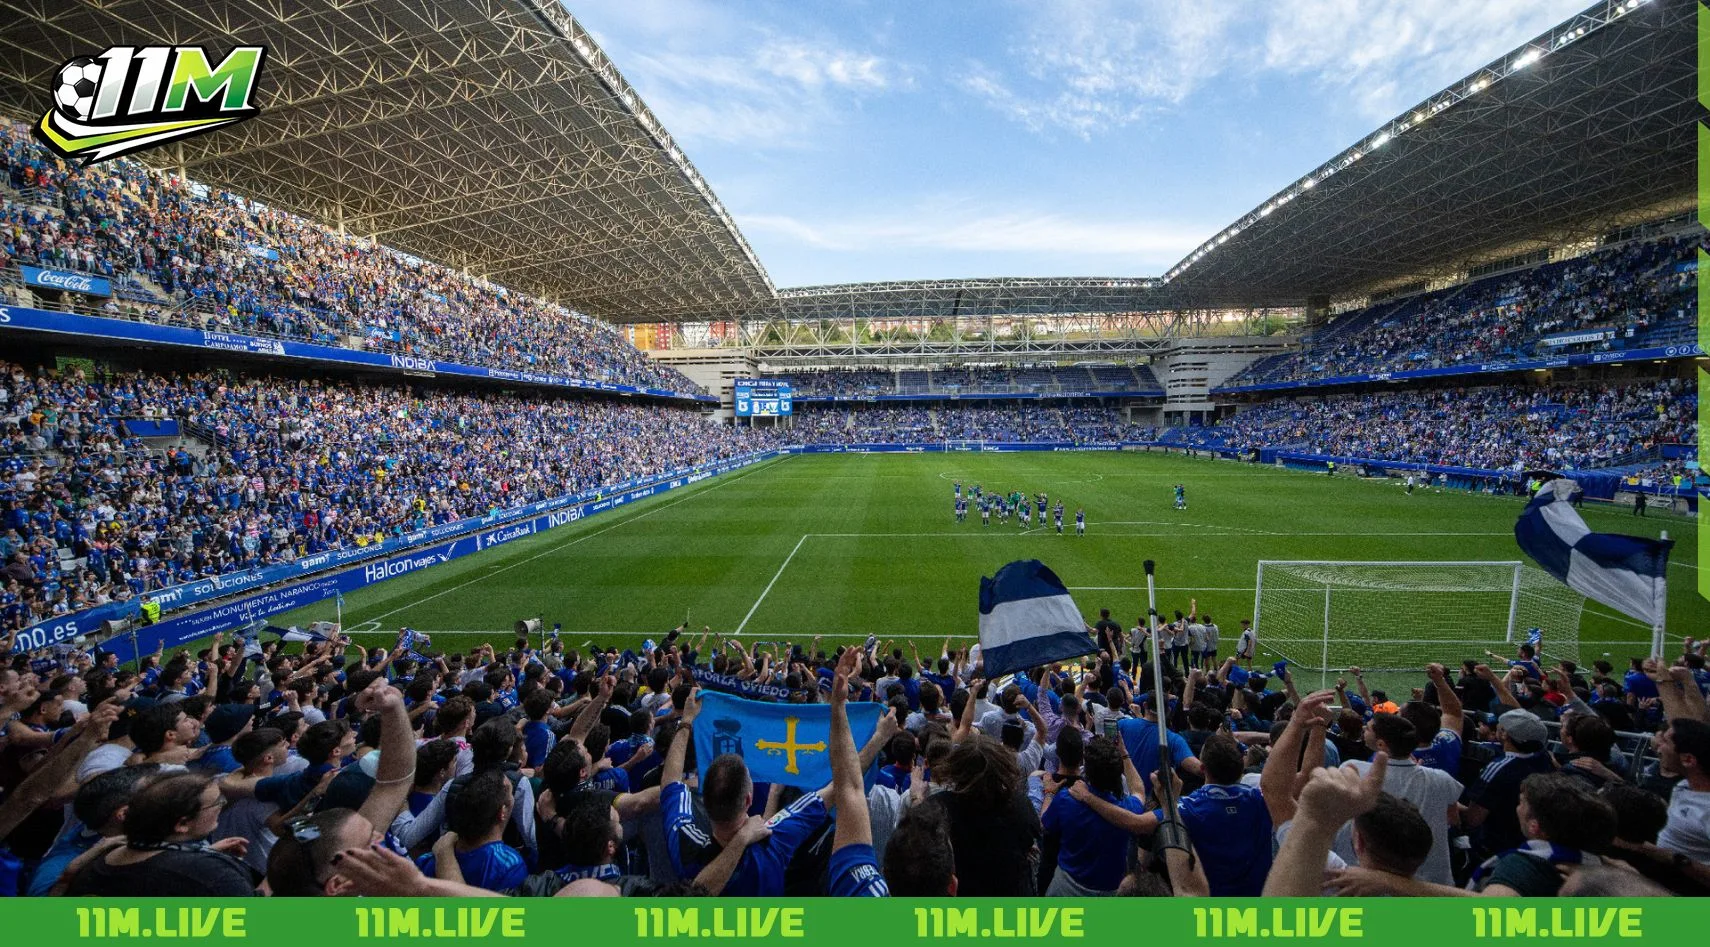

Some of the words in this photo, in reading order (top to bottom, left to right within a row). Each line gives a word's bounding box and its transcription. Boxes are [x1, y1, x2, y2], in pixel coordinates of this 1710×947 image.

[391, 353, 436, 371] INDIBA
[548, 507, 585, 528] INDIBA
[497, 524, 530, 541] CaixaBank
[337, 543, 383, 560] SOLUCIONES
[365, 559, 413, 583] Halcon
[413, 555, 436, 568] viajes
[213, 594, 279, 619] MONUMENTAL
[280, 582, 321, 599] NARANCO
[741, 680, 790, 698] OVIEDO
